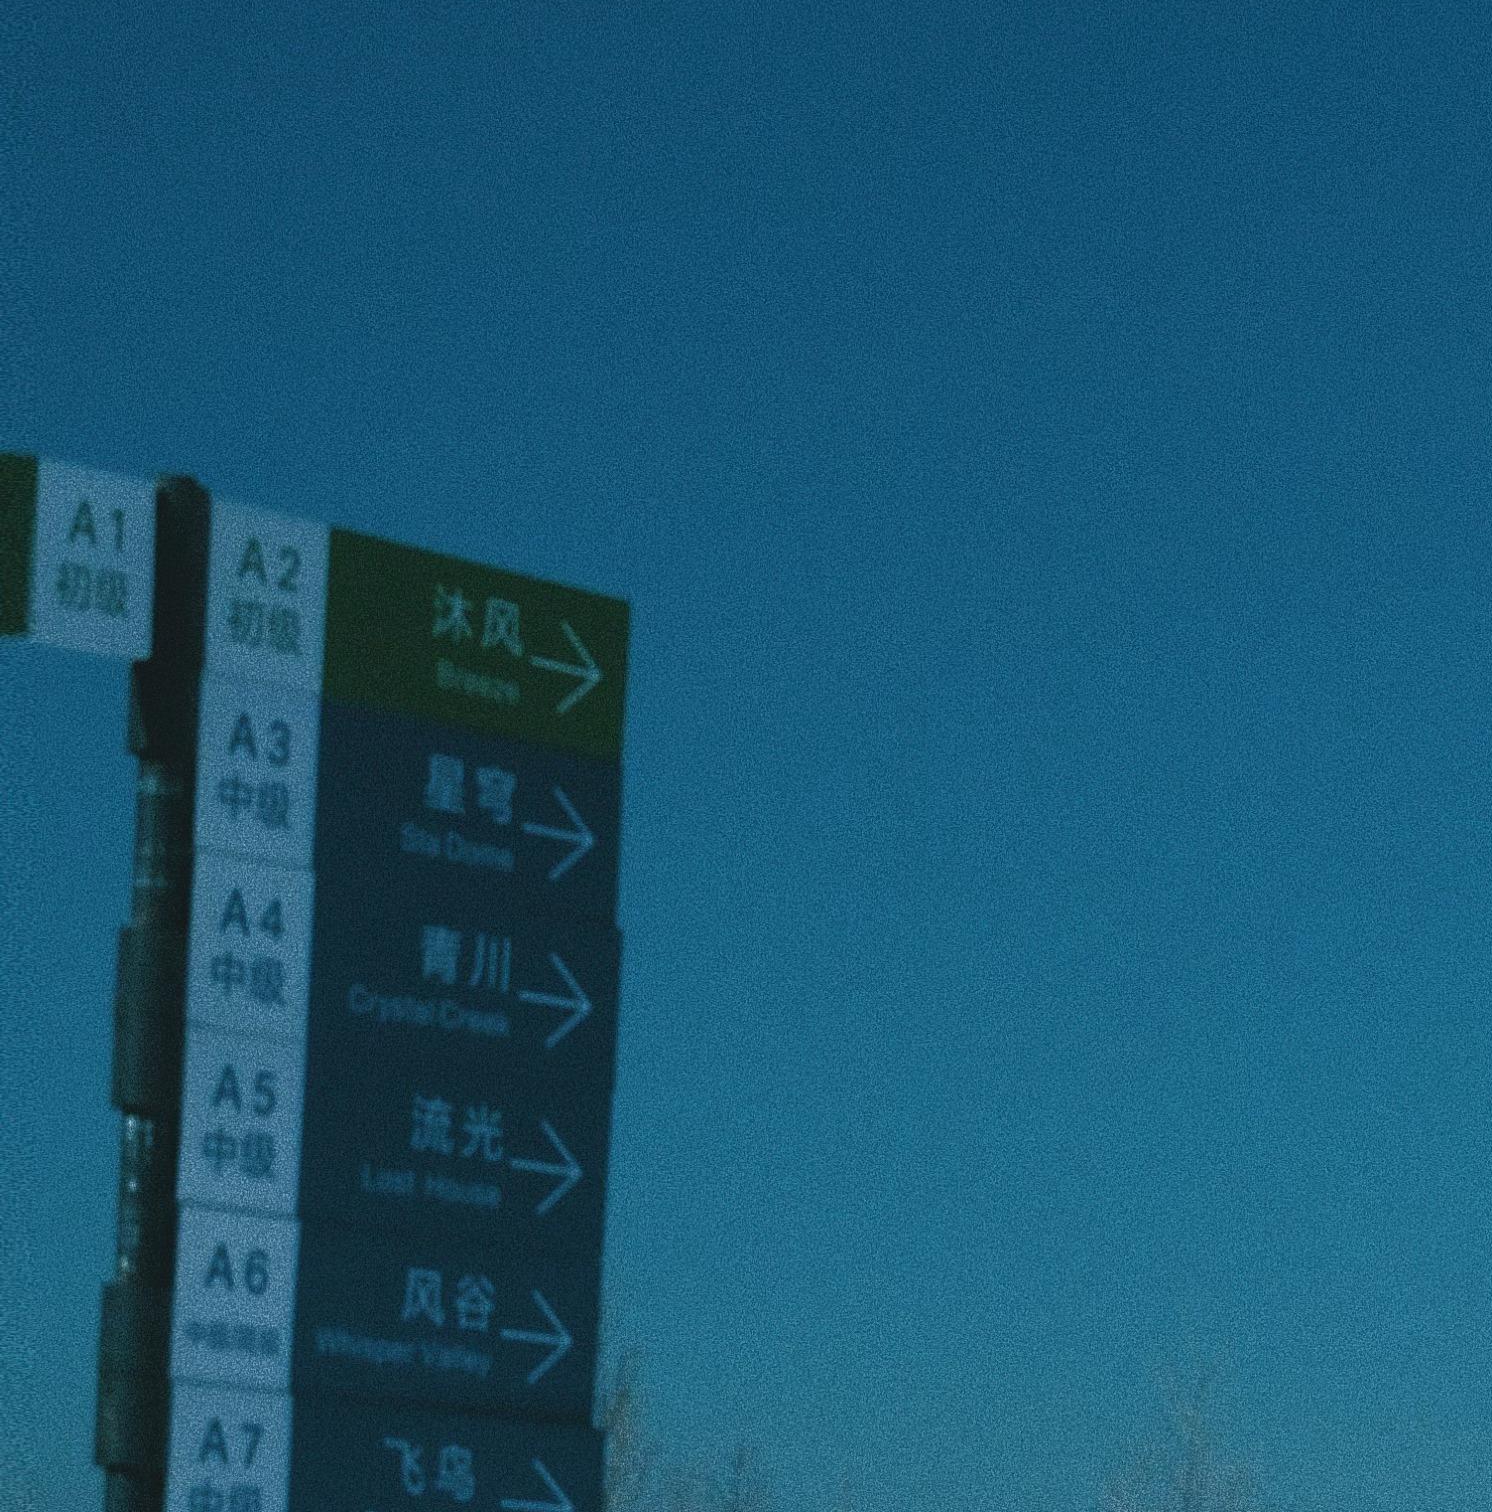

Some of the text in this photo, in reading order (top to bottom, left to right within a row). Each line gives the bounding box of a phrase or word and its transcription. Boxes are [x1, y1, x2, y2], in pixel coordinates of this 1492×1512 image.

[70, 499, 125, 551] A1
[239, 538, 300, 592] A2
[229, 599, 301, 655] 初级
[433, 583, 523, 657] 沐风
[230, 713, 291, 765] A3
[218, 775, 290, 828] 中级
[222, 889, 285, 940] A4
[211, 952, 286, 1006] 中级
[214, 1065, 277, 1115] A5
[204, 1128, 276, 1177] 中级
[411, 1094, 504, 1161] 流光
[206, 1242, 269, 1294] A6
[403, 1267, 497, 1331] 风谷
[200, 1417, 263, 1468] A7
[385, 1436, 476, 1501] 飞鸟
